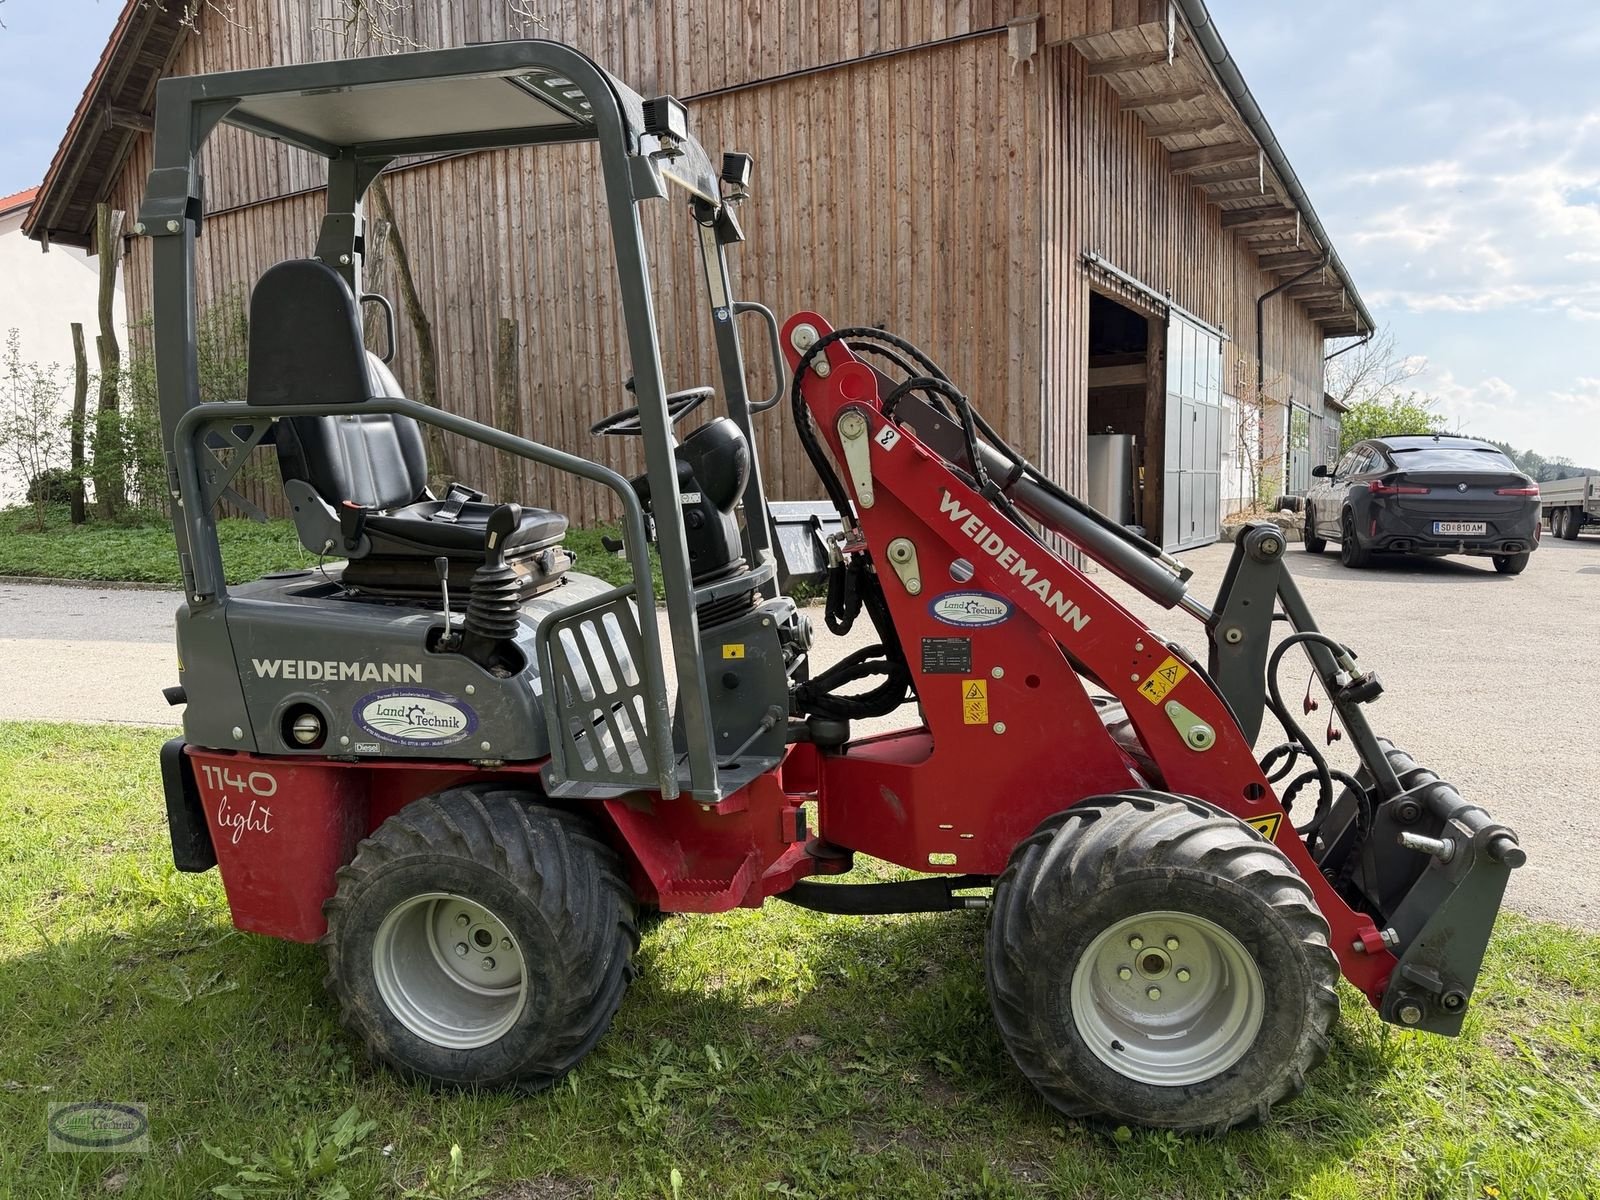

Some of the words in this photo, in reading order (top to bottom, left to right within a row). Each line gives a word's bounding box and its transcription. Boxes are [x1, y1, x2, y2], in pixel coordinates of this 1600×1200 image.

[1441, 524, 1451, 532] SD
[1456, 524, 1470, 532] 810
[939, 489, 1091, 632] WEIDEMANN
[944, 601, 965, 609] Land
[972, 606, 1002, 615] Technik
[251, 658, 423, 683] WEIDEMANN
[376, 704, 405, 717] Land
[415, 715, 460, 729] Technik
[356, 744, 379, 752] Diesel
[202, 765, 277, 797] 1140
[218, 795, 274, 844] light
